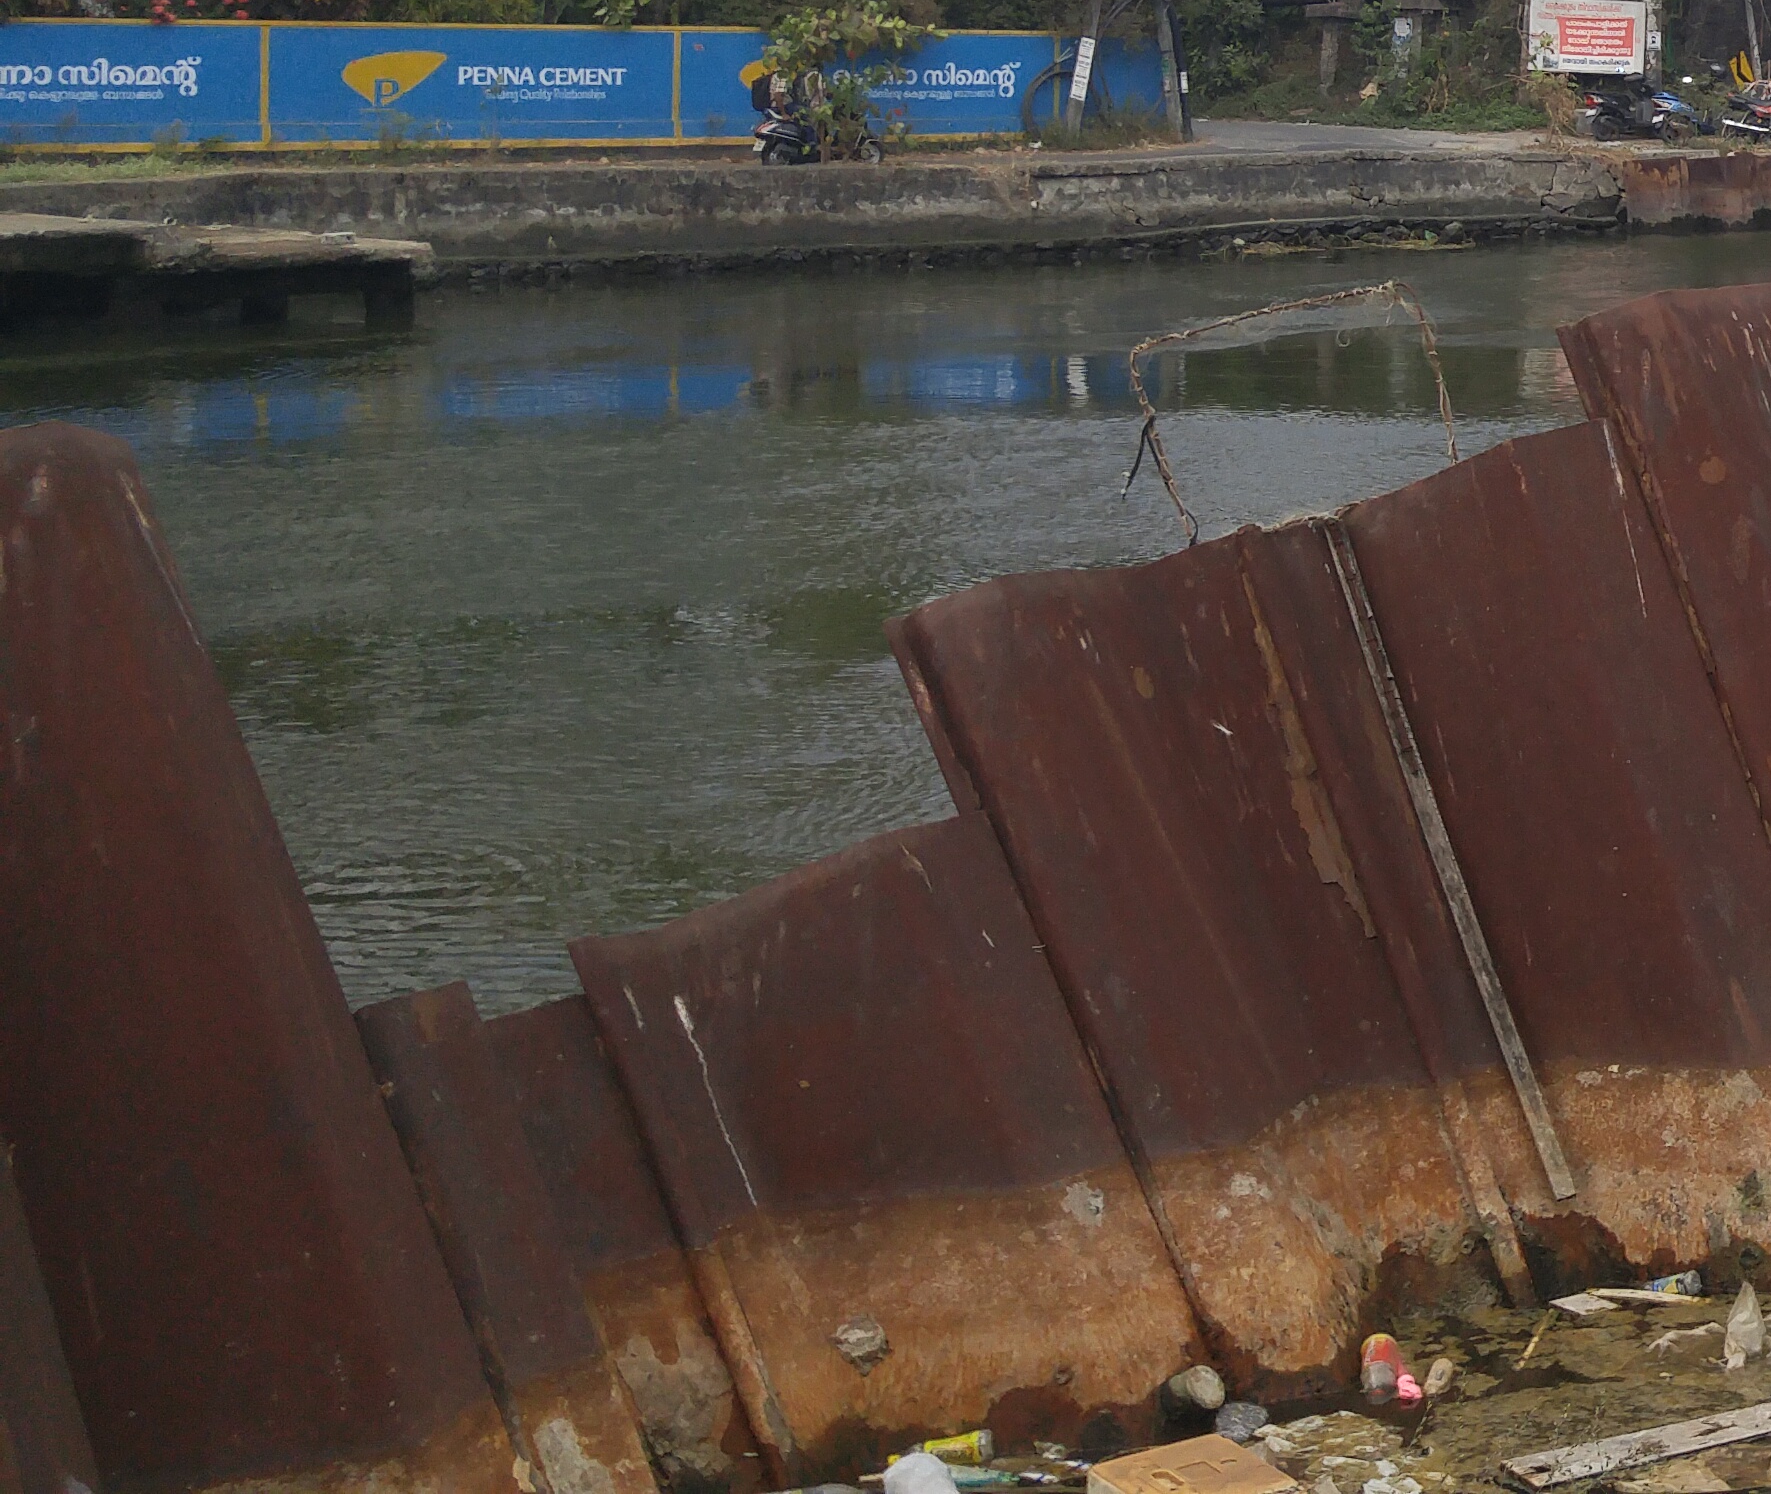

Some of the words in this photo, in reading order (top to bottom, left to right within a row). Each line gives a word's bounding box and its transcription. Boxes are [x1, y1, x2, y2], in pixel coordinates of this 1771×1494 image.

[0, 65, 52, 85] ന്നാ
[458, 66, 535, 86] PENNA
[539, 67, 627, 86] CEMENT
[520, 88, 552, 103] Quality
[553, 88, 606, 101] Relationships
